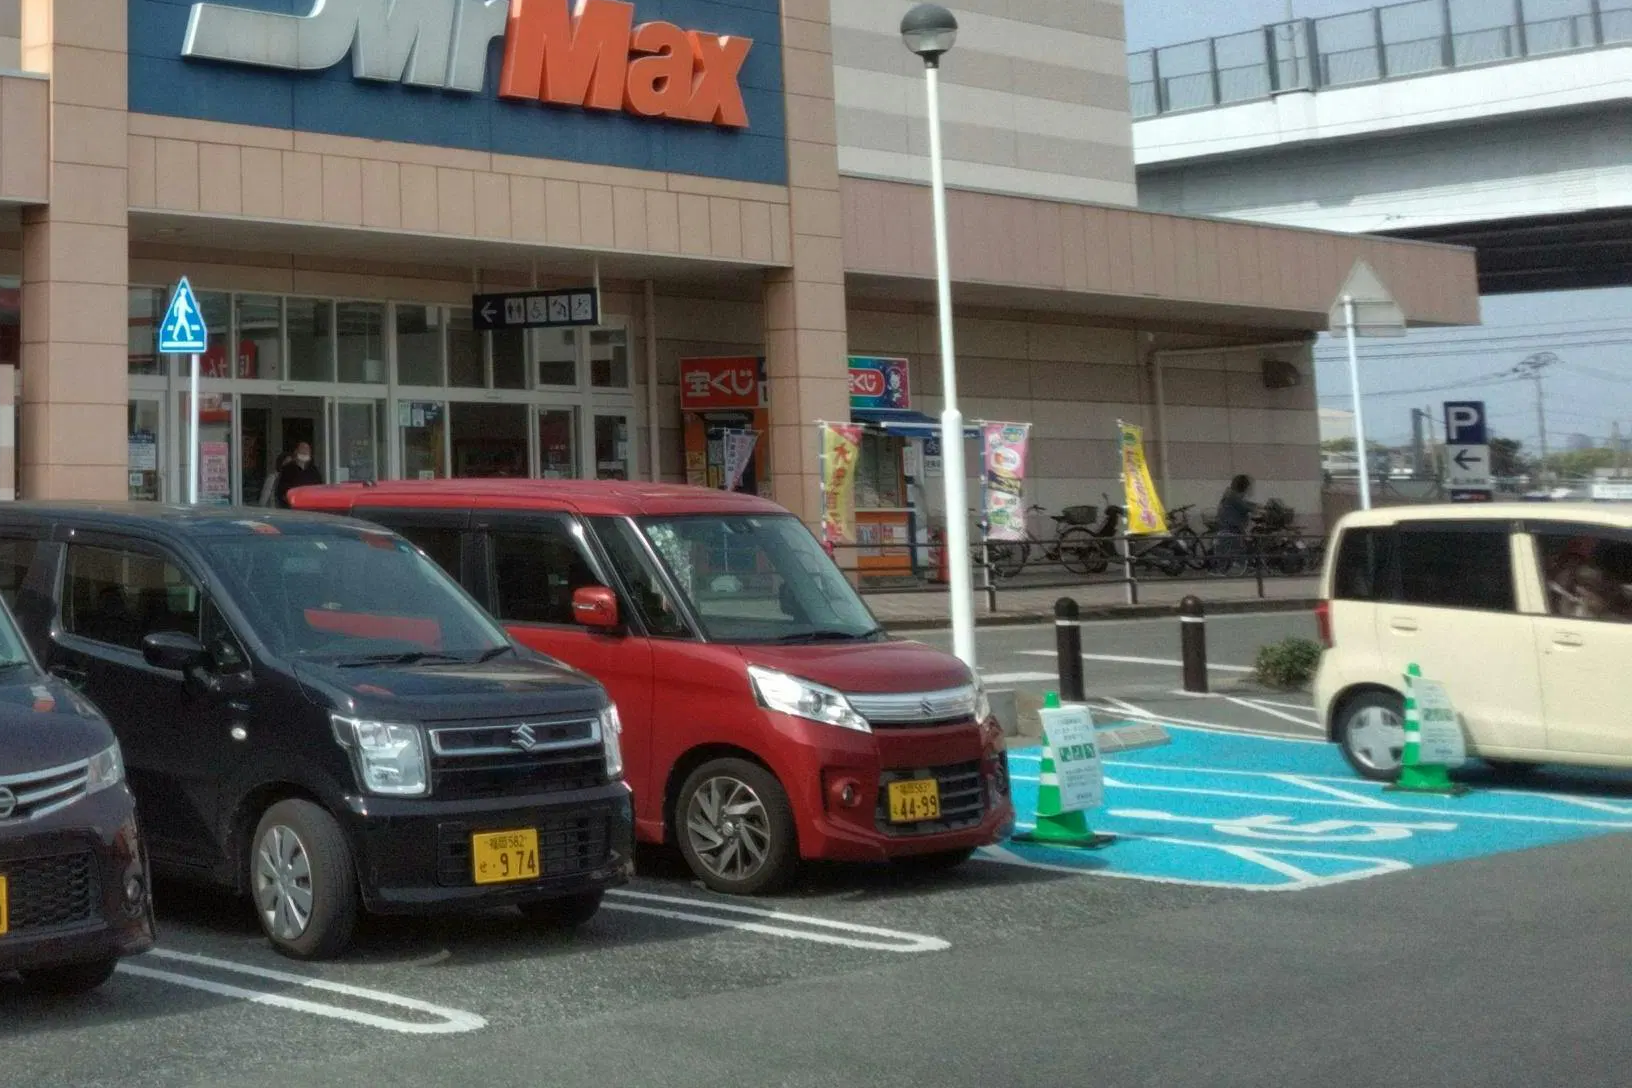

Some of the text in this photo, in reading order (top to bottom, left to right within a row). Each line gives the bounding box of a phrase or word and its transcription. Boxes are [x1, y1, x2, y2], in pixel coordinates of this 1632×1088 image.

[685, 368, 753, 398] 宝くじ
[1447, 406, 1479, 440] P
[900, 795, 937, 820] 44-99
